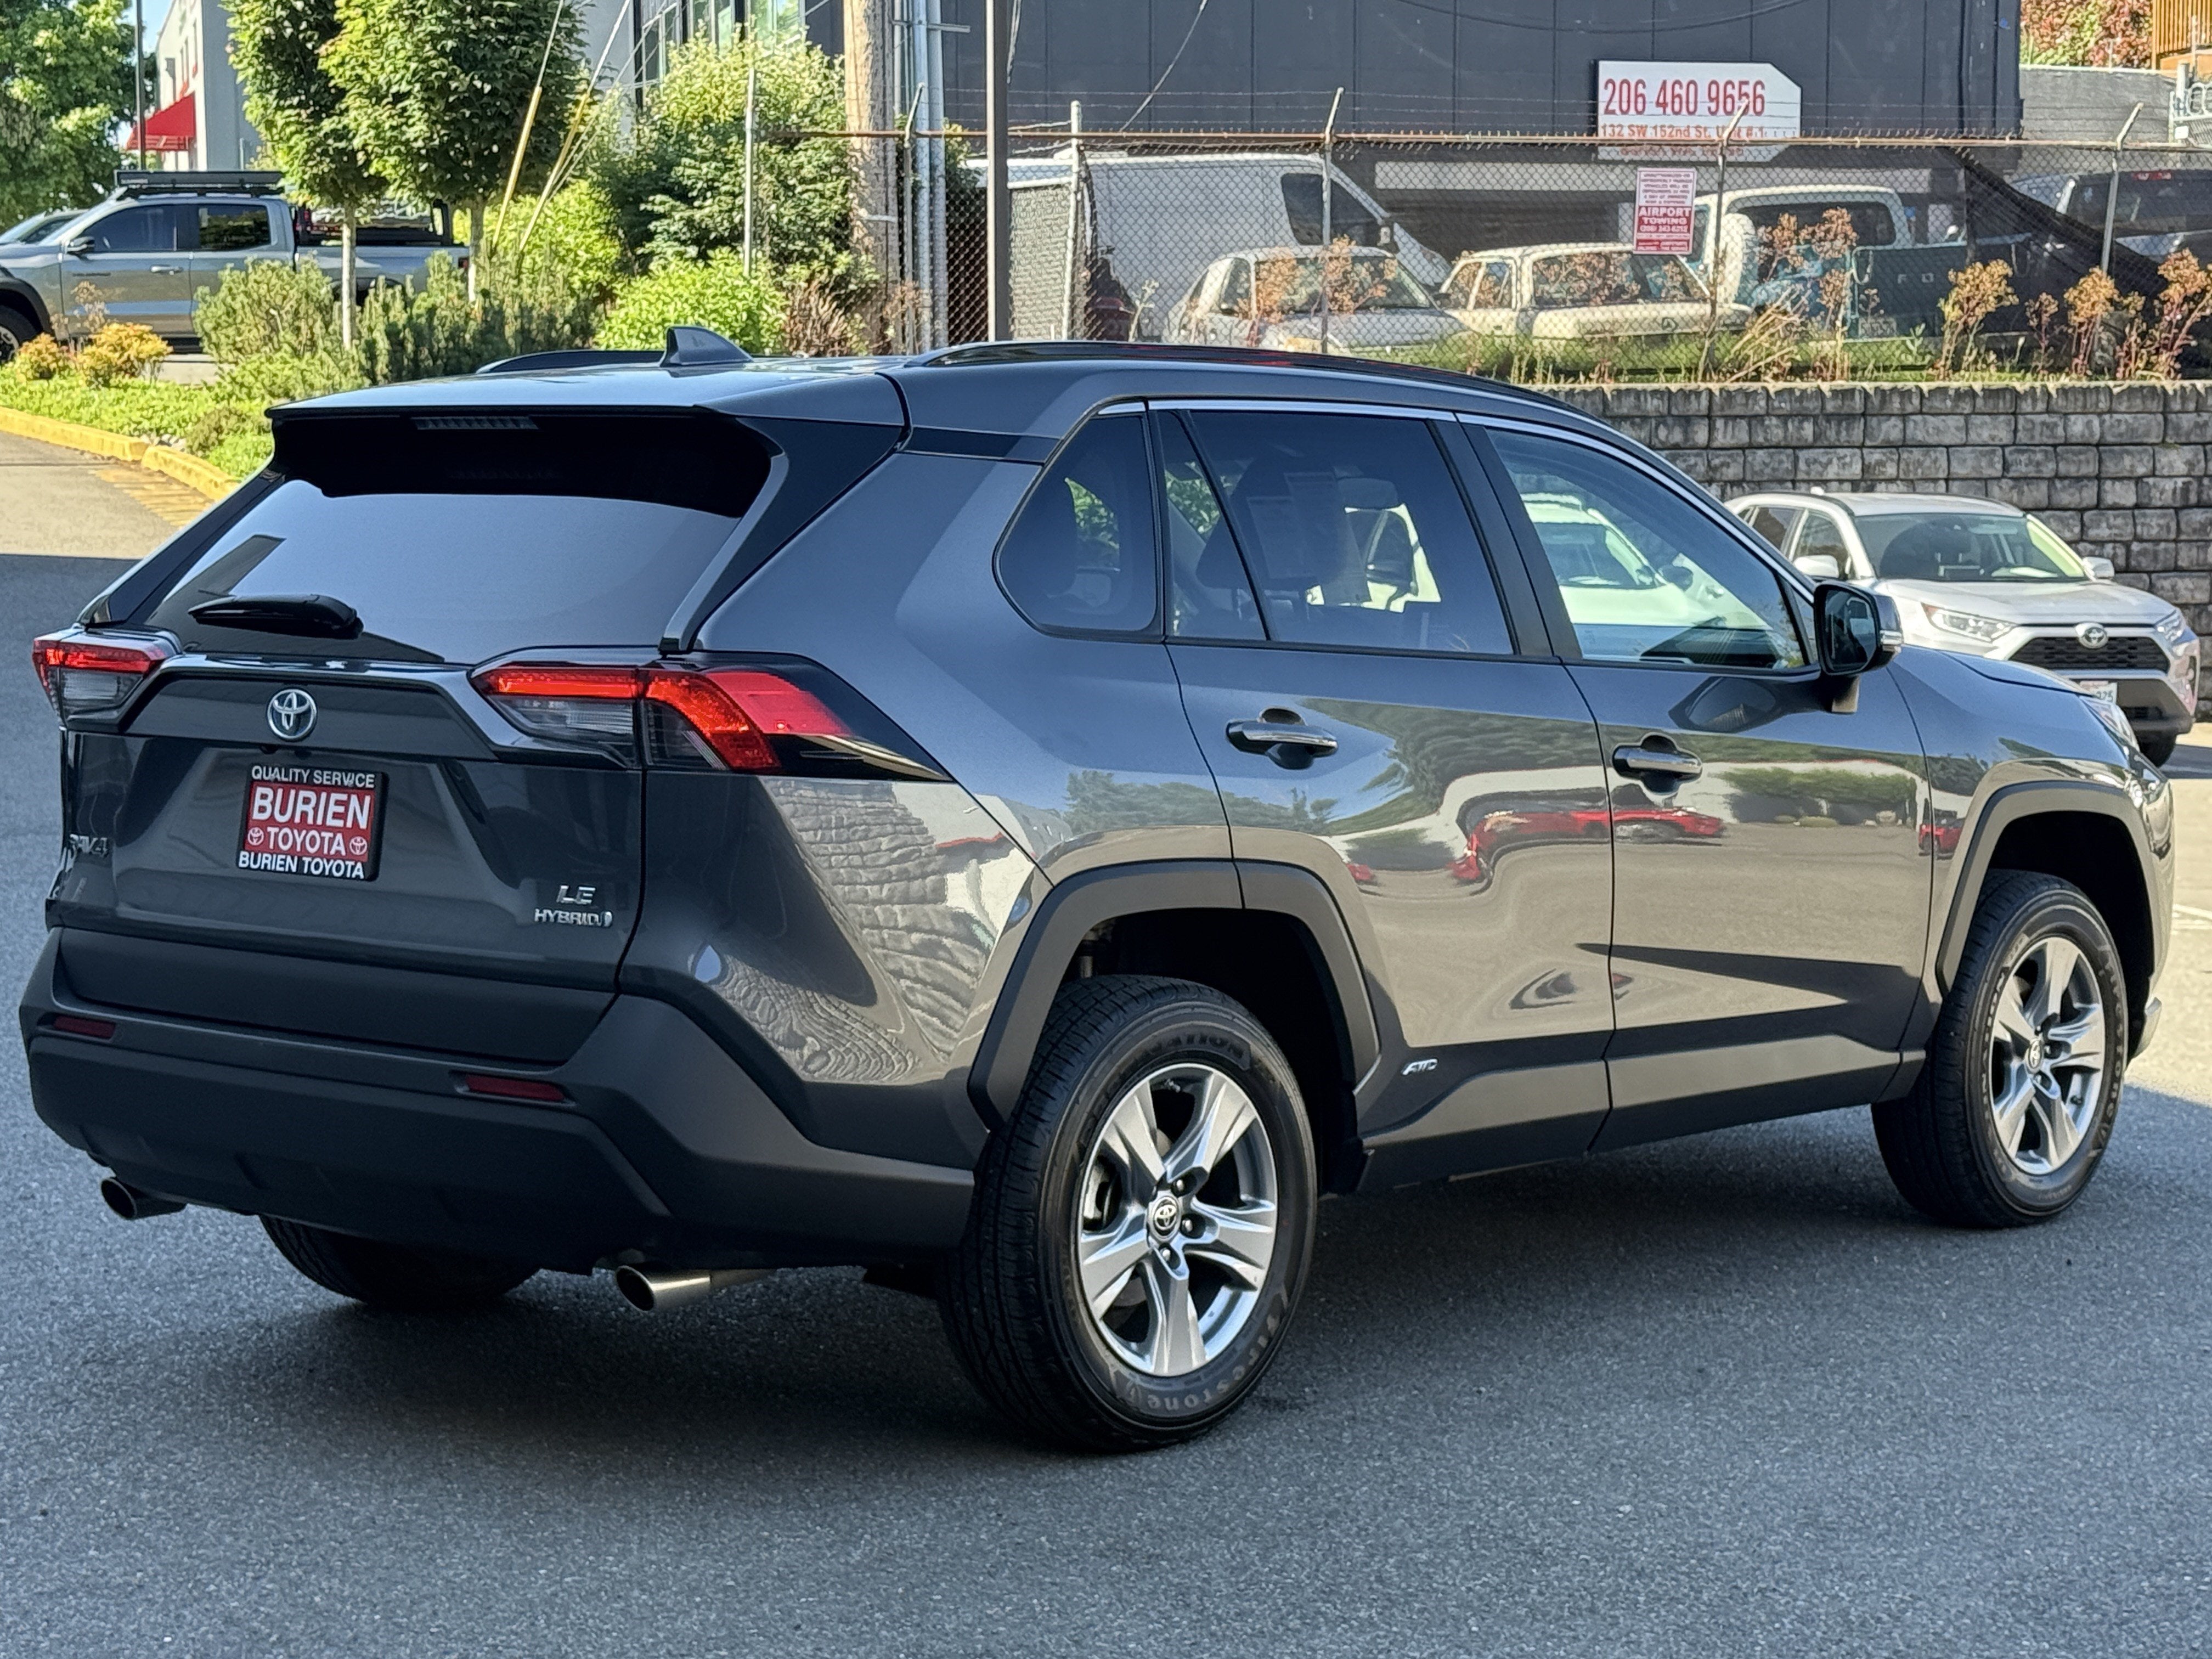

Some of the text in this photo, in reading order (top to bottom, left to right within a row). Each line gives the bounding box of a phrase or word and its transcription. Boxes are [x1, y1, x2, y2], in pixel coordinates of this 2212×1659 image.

[1604, 78, 1765, 116] 206 460 9656
[1601, 123, 1624, 137] 132
[1627, 124, 1649, 137] SW
[1652, 124, 1690, 138] 152nd
[1694, 125, 1711, 138] St.
[1716, 125, 1742, 138] Uit
[1639, 207, 1691, 217] AIRPORT
[252, 765, 375, 788] QUALITY SERVICE
[252, 786, 371, 830] BURIEN
[69, 834, 109, 857] RAV4
[267, 827, 346, 856] TOYOTA
[238, 851, 364, 879] BURIEN TOYOTA
[556, 885, 596, 905] LE
[534, 909, 602, 927] HYBRID
[1146, 1310, 1282, 1413] Firestone
